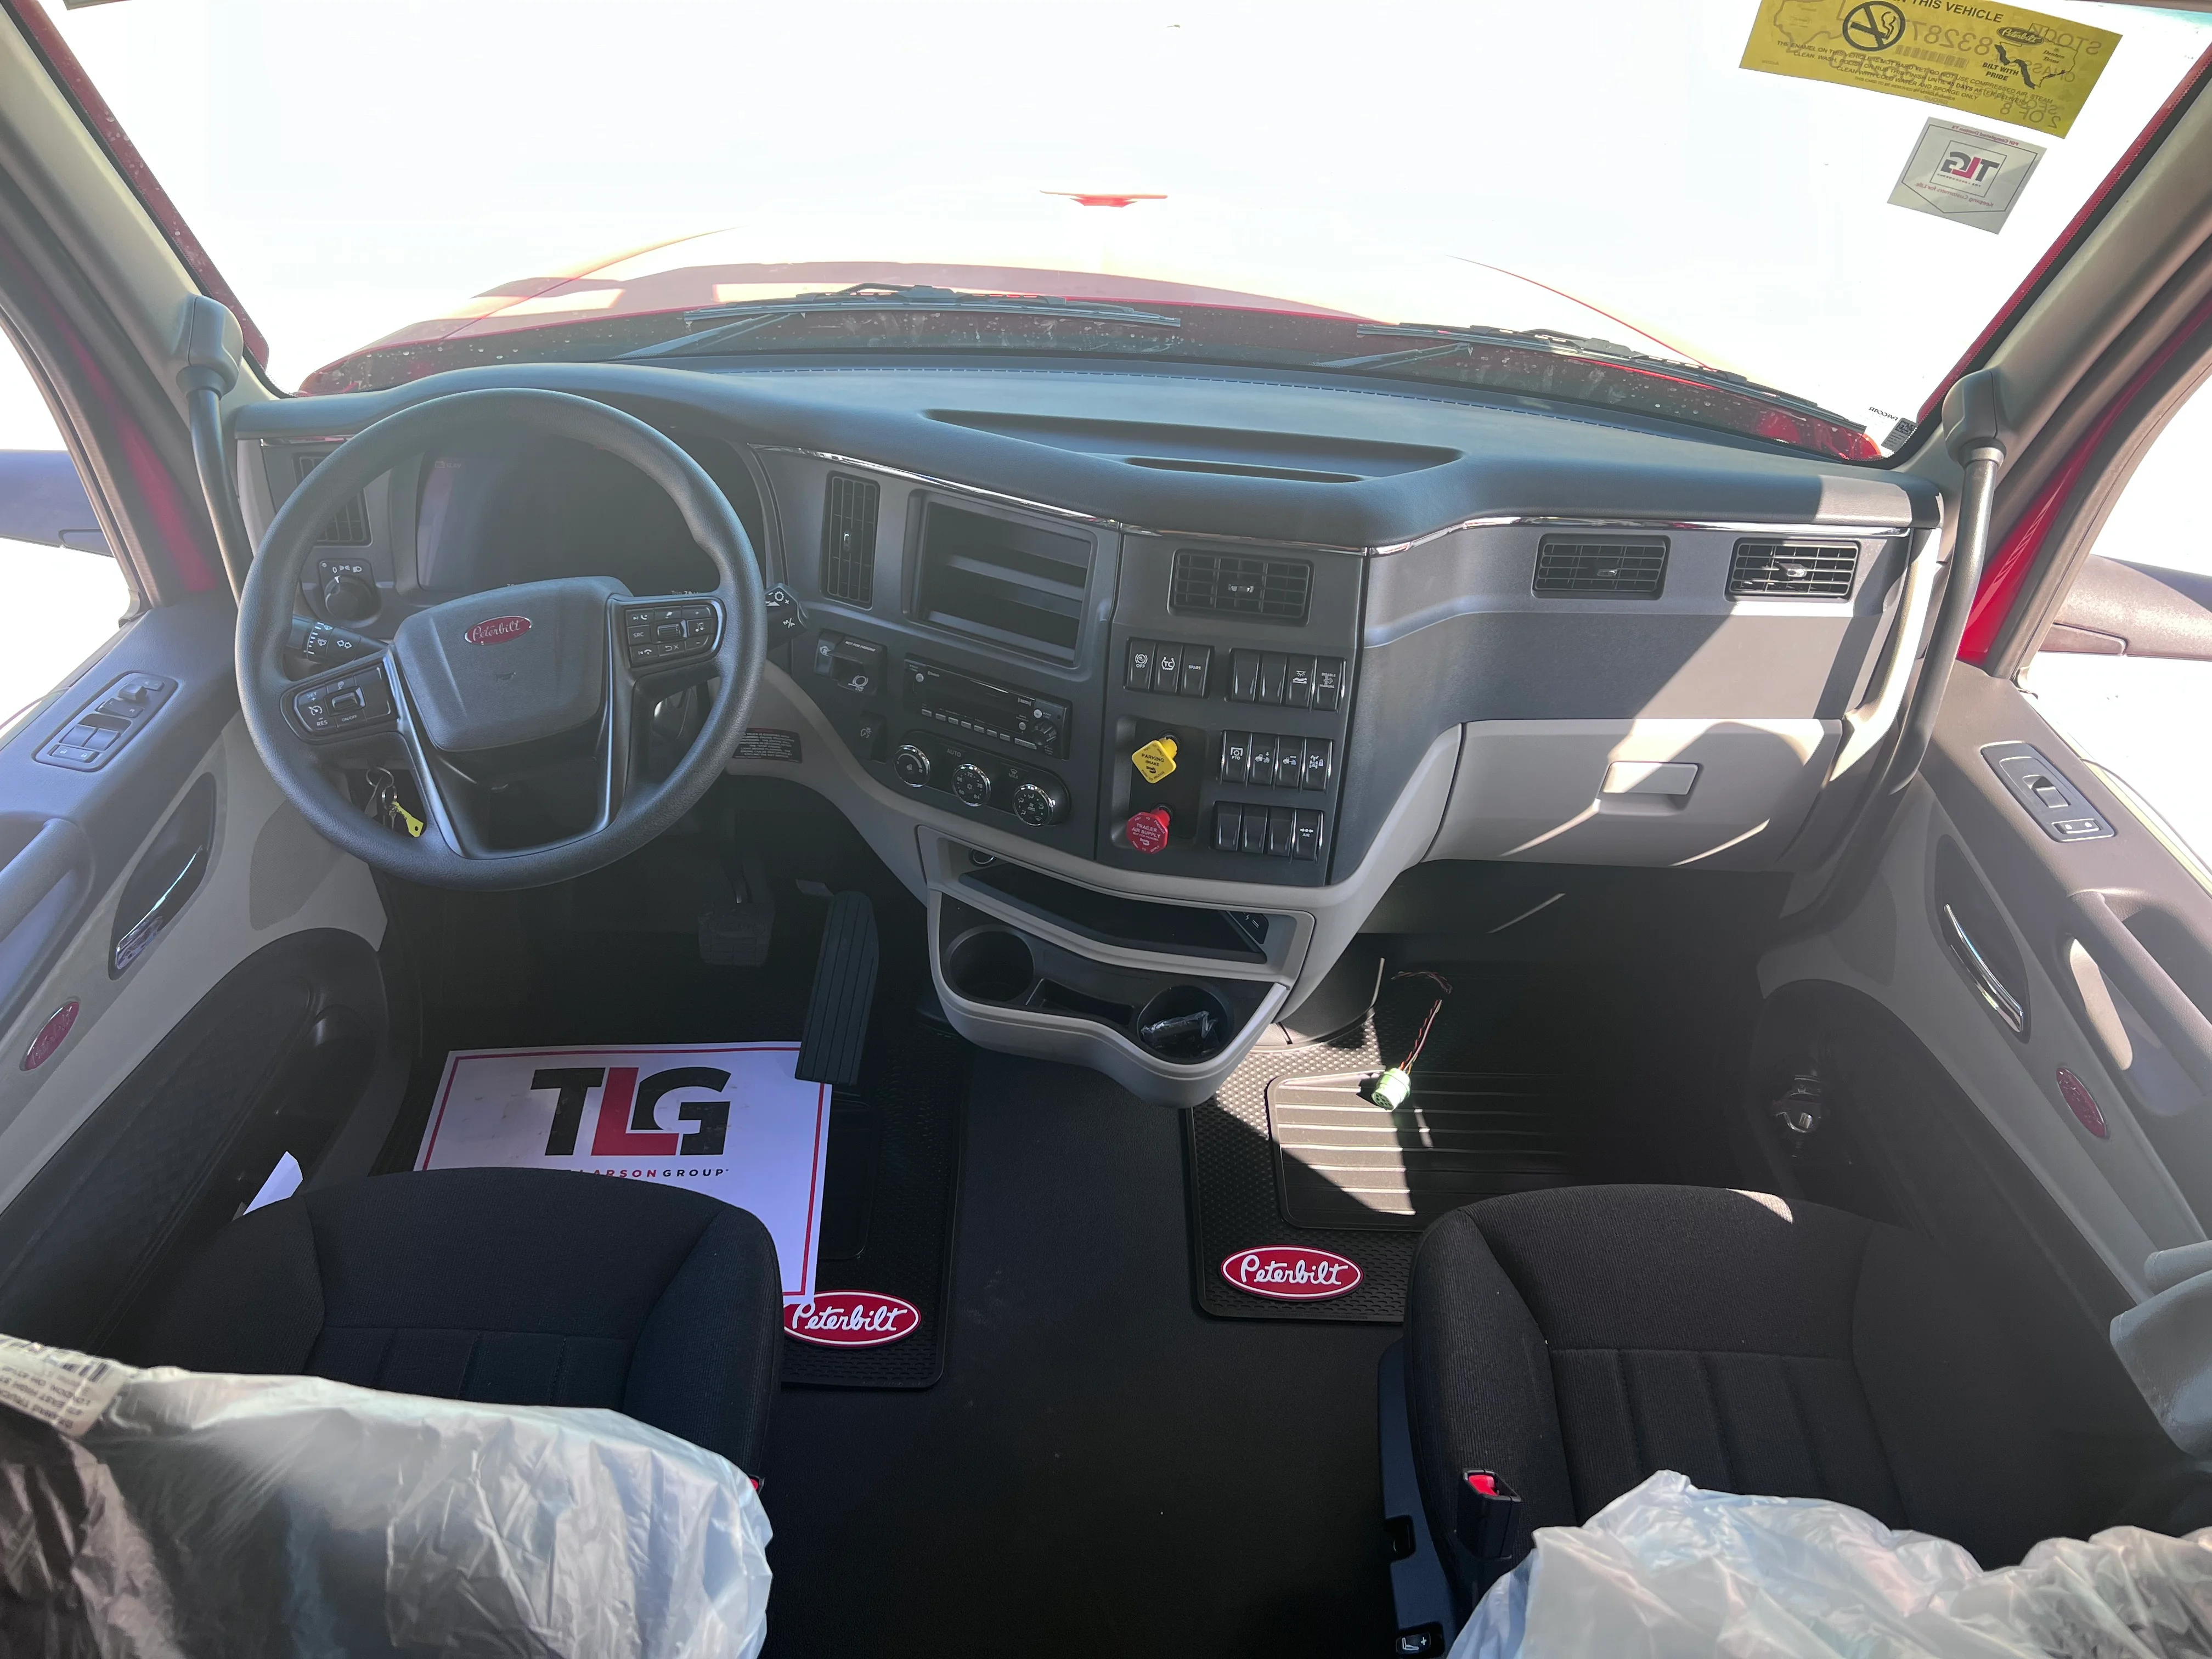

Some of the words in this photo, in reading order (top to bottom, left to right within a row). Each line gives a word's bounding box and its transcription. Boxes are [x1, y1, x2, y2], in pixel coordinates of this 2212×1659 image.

[1946, 2, 2004, 23] VEHICLE
[2001, 27, 2042, 44] Peterbilt
[1790, 43, 1815, 51] ENAMEL
[1970, 78, 2016, 93] COMPRESSED
[2030, 94, 2053, 104] STEAM
[1982, 62, 1999, 70] BILT
[2000, 66, 2019, 76] WITH
[1985, 71, 2008, 81] PRIDE
[1933, 86, 1960, 95] SPONGE
[1961, 92, 1979, 100] ONLY
[1955, 83, 1973, 91] DAYS
[783, 617, 795, 628] M/A
[473, 619, 524, 641] Peterbilt
[947, 748, 961, 757] AUTO
[1142, 753, 1164, 762] PARKING
[1137, 823, 1157, 832] TRAILER
[1141, 830, 1161, 838] SUPPLY
[530, 1066, 731, 1156] TLG
[1240, 1255, 1348, 1285] Peterbilt
[792, 1302, 907, 1331] Peterbilt
